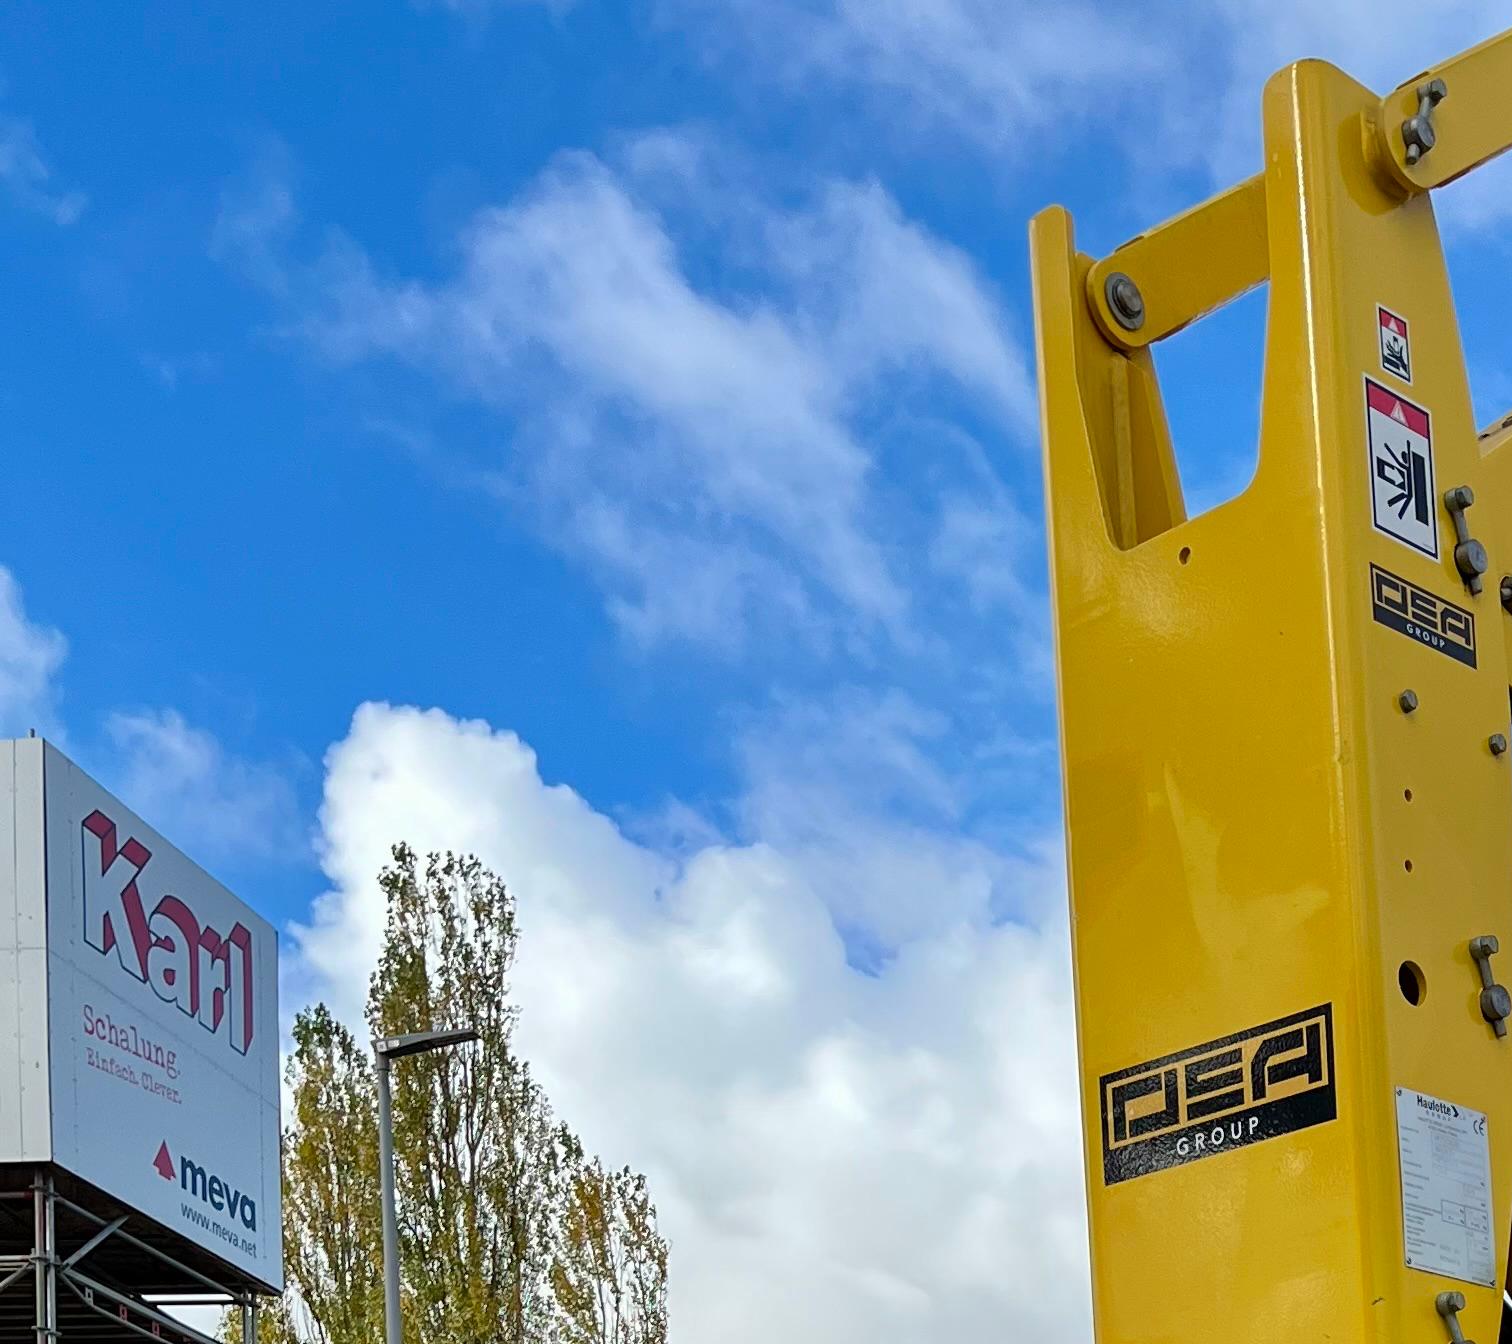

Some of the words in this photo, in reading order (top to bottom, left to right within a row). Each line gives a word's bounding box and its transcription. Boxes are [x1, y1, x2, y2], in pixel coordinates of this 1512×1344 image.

[1406, 623, 1446, 649] GROUP
[82, 809, 254, 1056] Karl
[83, 1003, 181, 1080] Schalung.
[1416, 1095, 1452, 1117] Haulotte
[1175, 1116, 1260, 1157] GROUP
[181, 1154, 256, 1233] meva
[181, 1202, 257, 1259] www.meva.net
